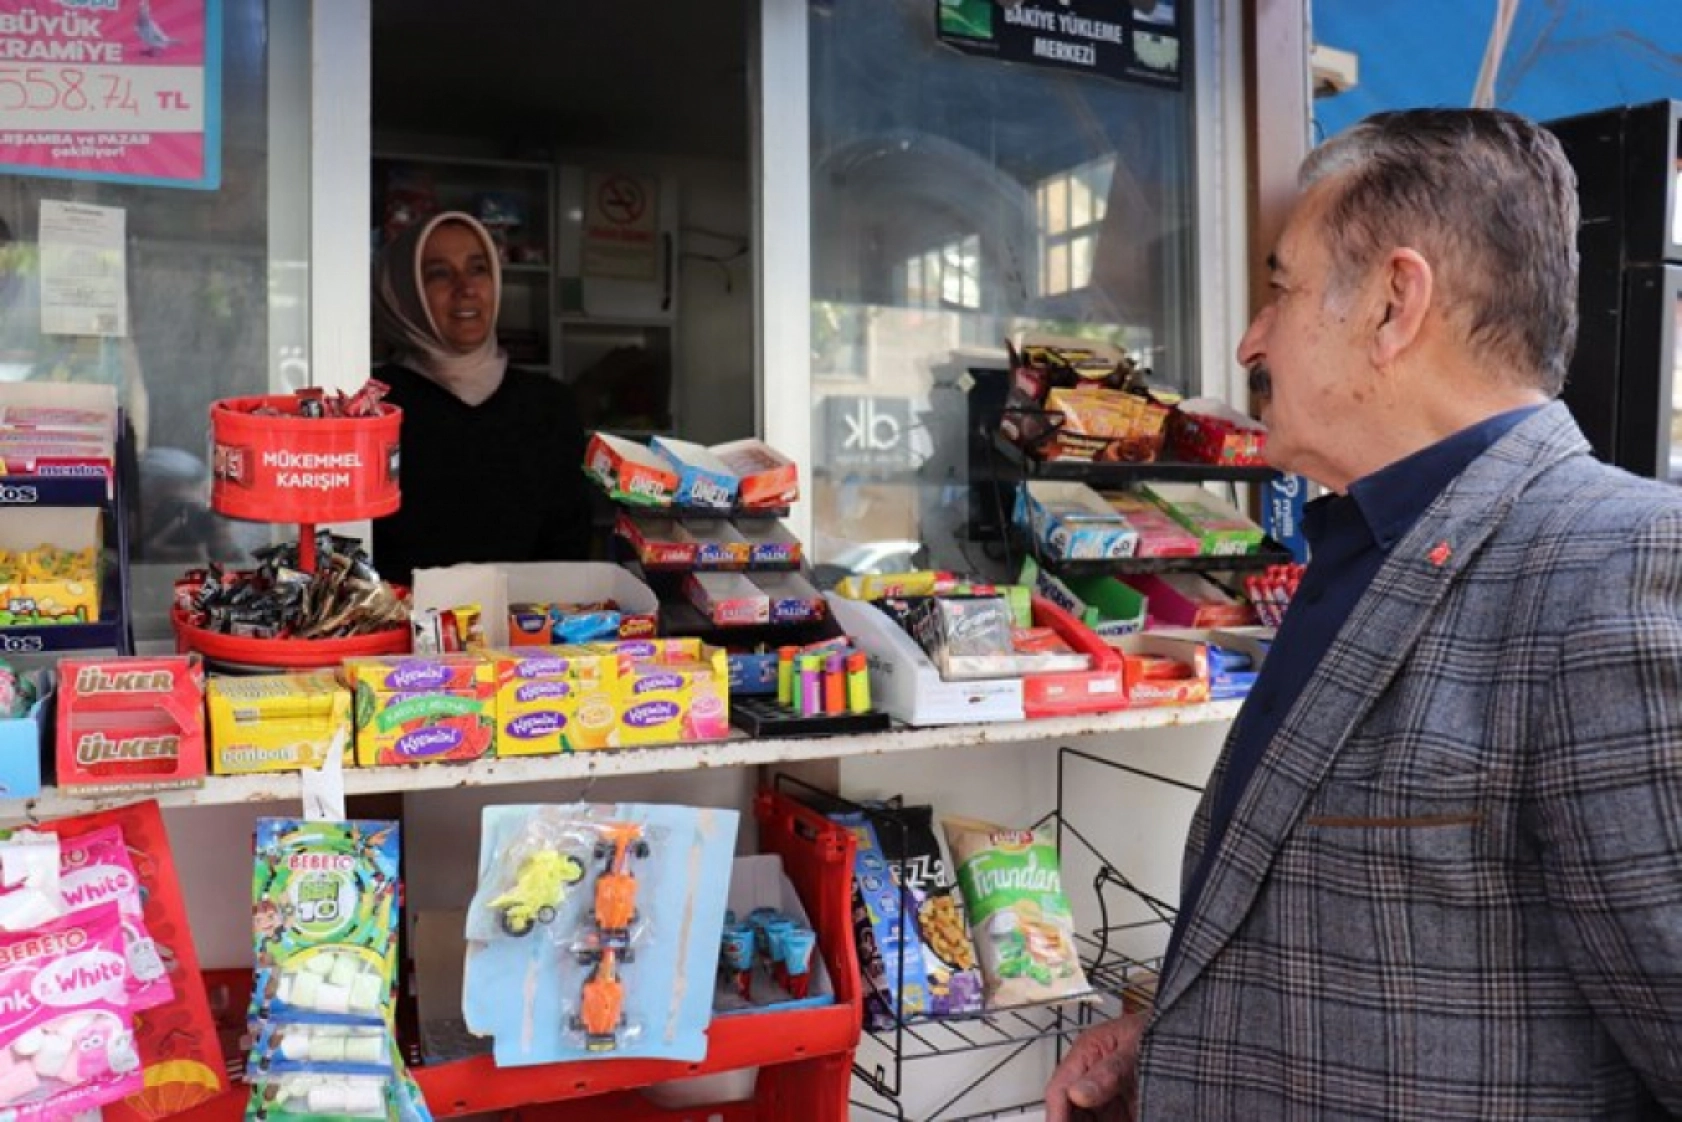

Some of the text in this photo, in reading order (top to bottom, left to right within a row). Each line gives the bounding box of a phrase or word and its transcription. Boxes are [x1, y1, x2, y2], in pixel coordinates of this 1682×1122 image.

[0, 9, 101, 37] BÜYÜK
[1058, 11, 1123, 44] YÜKLEME
[1033, 36, 1096, 66] MERKEZİ
[155, 91, 190, 110] TL
[76, 135, 95, 145] ve
[97, 133, 150, 145] PAZAR
[263, 448, 363, 468] MÜKEMMEL
[276, 473, 349, 491] KARIŞIM
[77, 666, 173, 696] ÜLKER
[77, 733, 180, 764] ÜLKER
[288, 855, 355, 871] BEBETO
[61, 875, 130, 906] White
[0, 928, 87, 964] BEBETO
[55, 961, 124, 992] White
